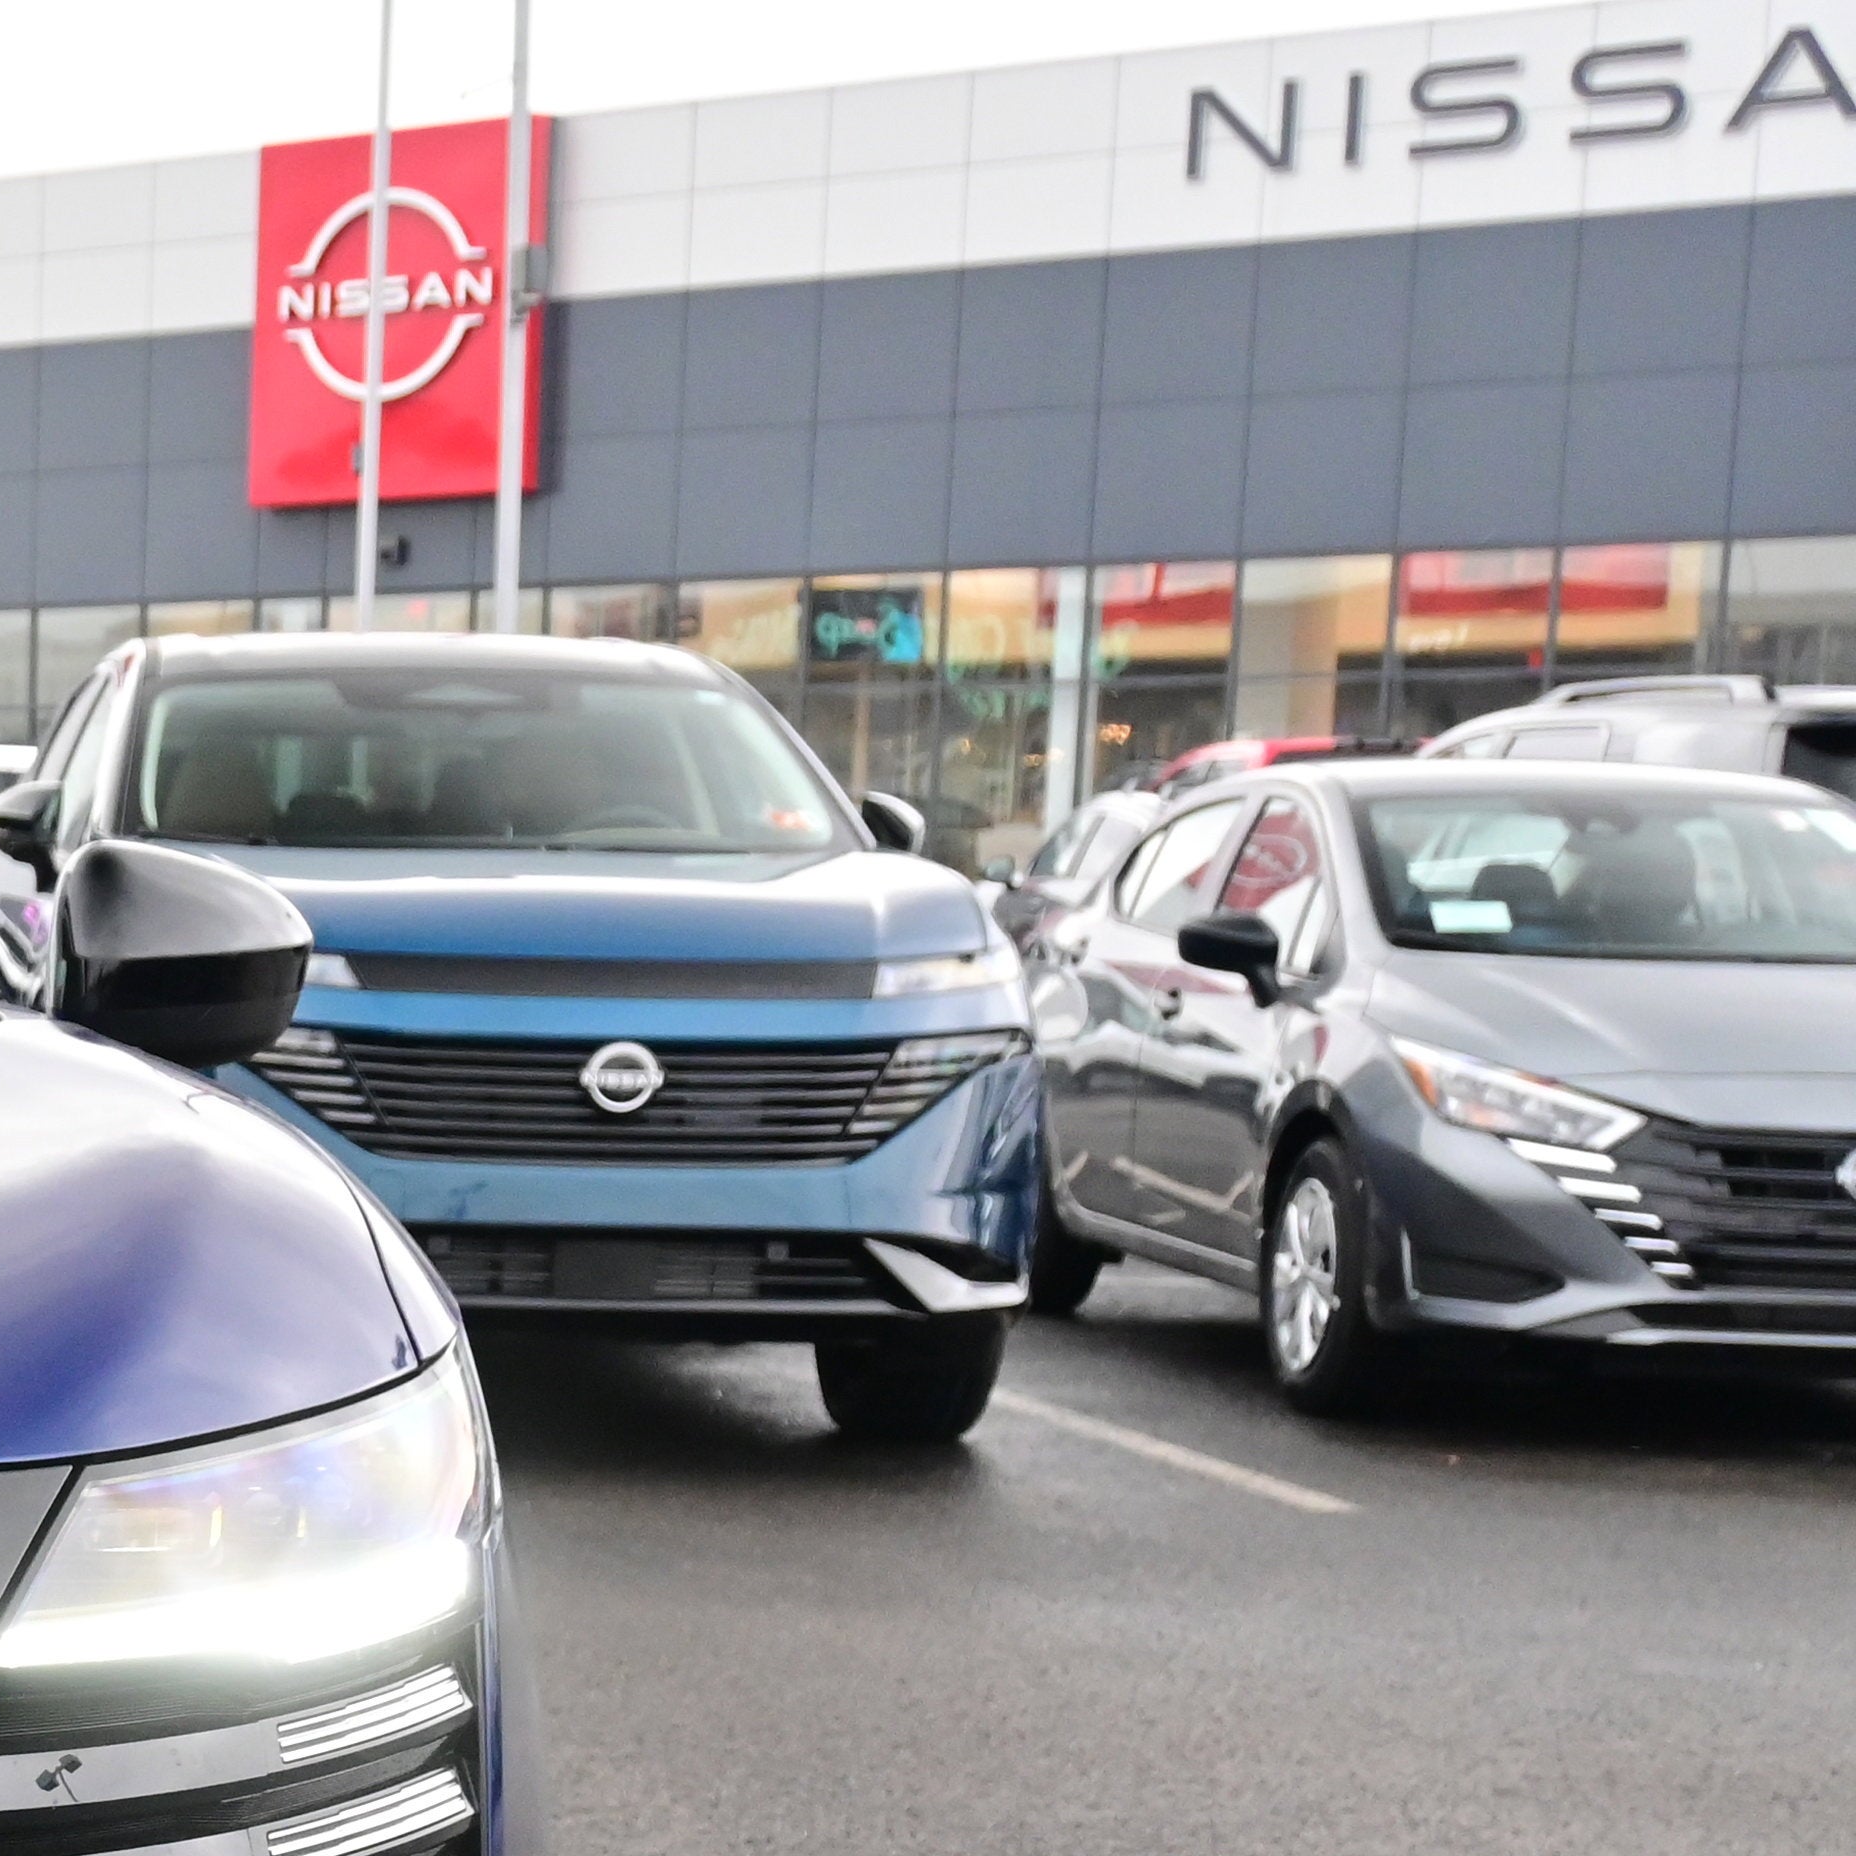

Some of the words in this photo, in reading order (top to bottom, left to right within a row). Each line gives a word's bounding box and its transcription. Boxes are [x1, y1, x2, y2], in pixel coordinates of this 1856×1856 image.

[1188, 26, 1856, 179] NISSA
[277, 266, 493, 322] NISSAN
[583, 1072, 663, 1090] NISSAN
